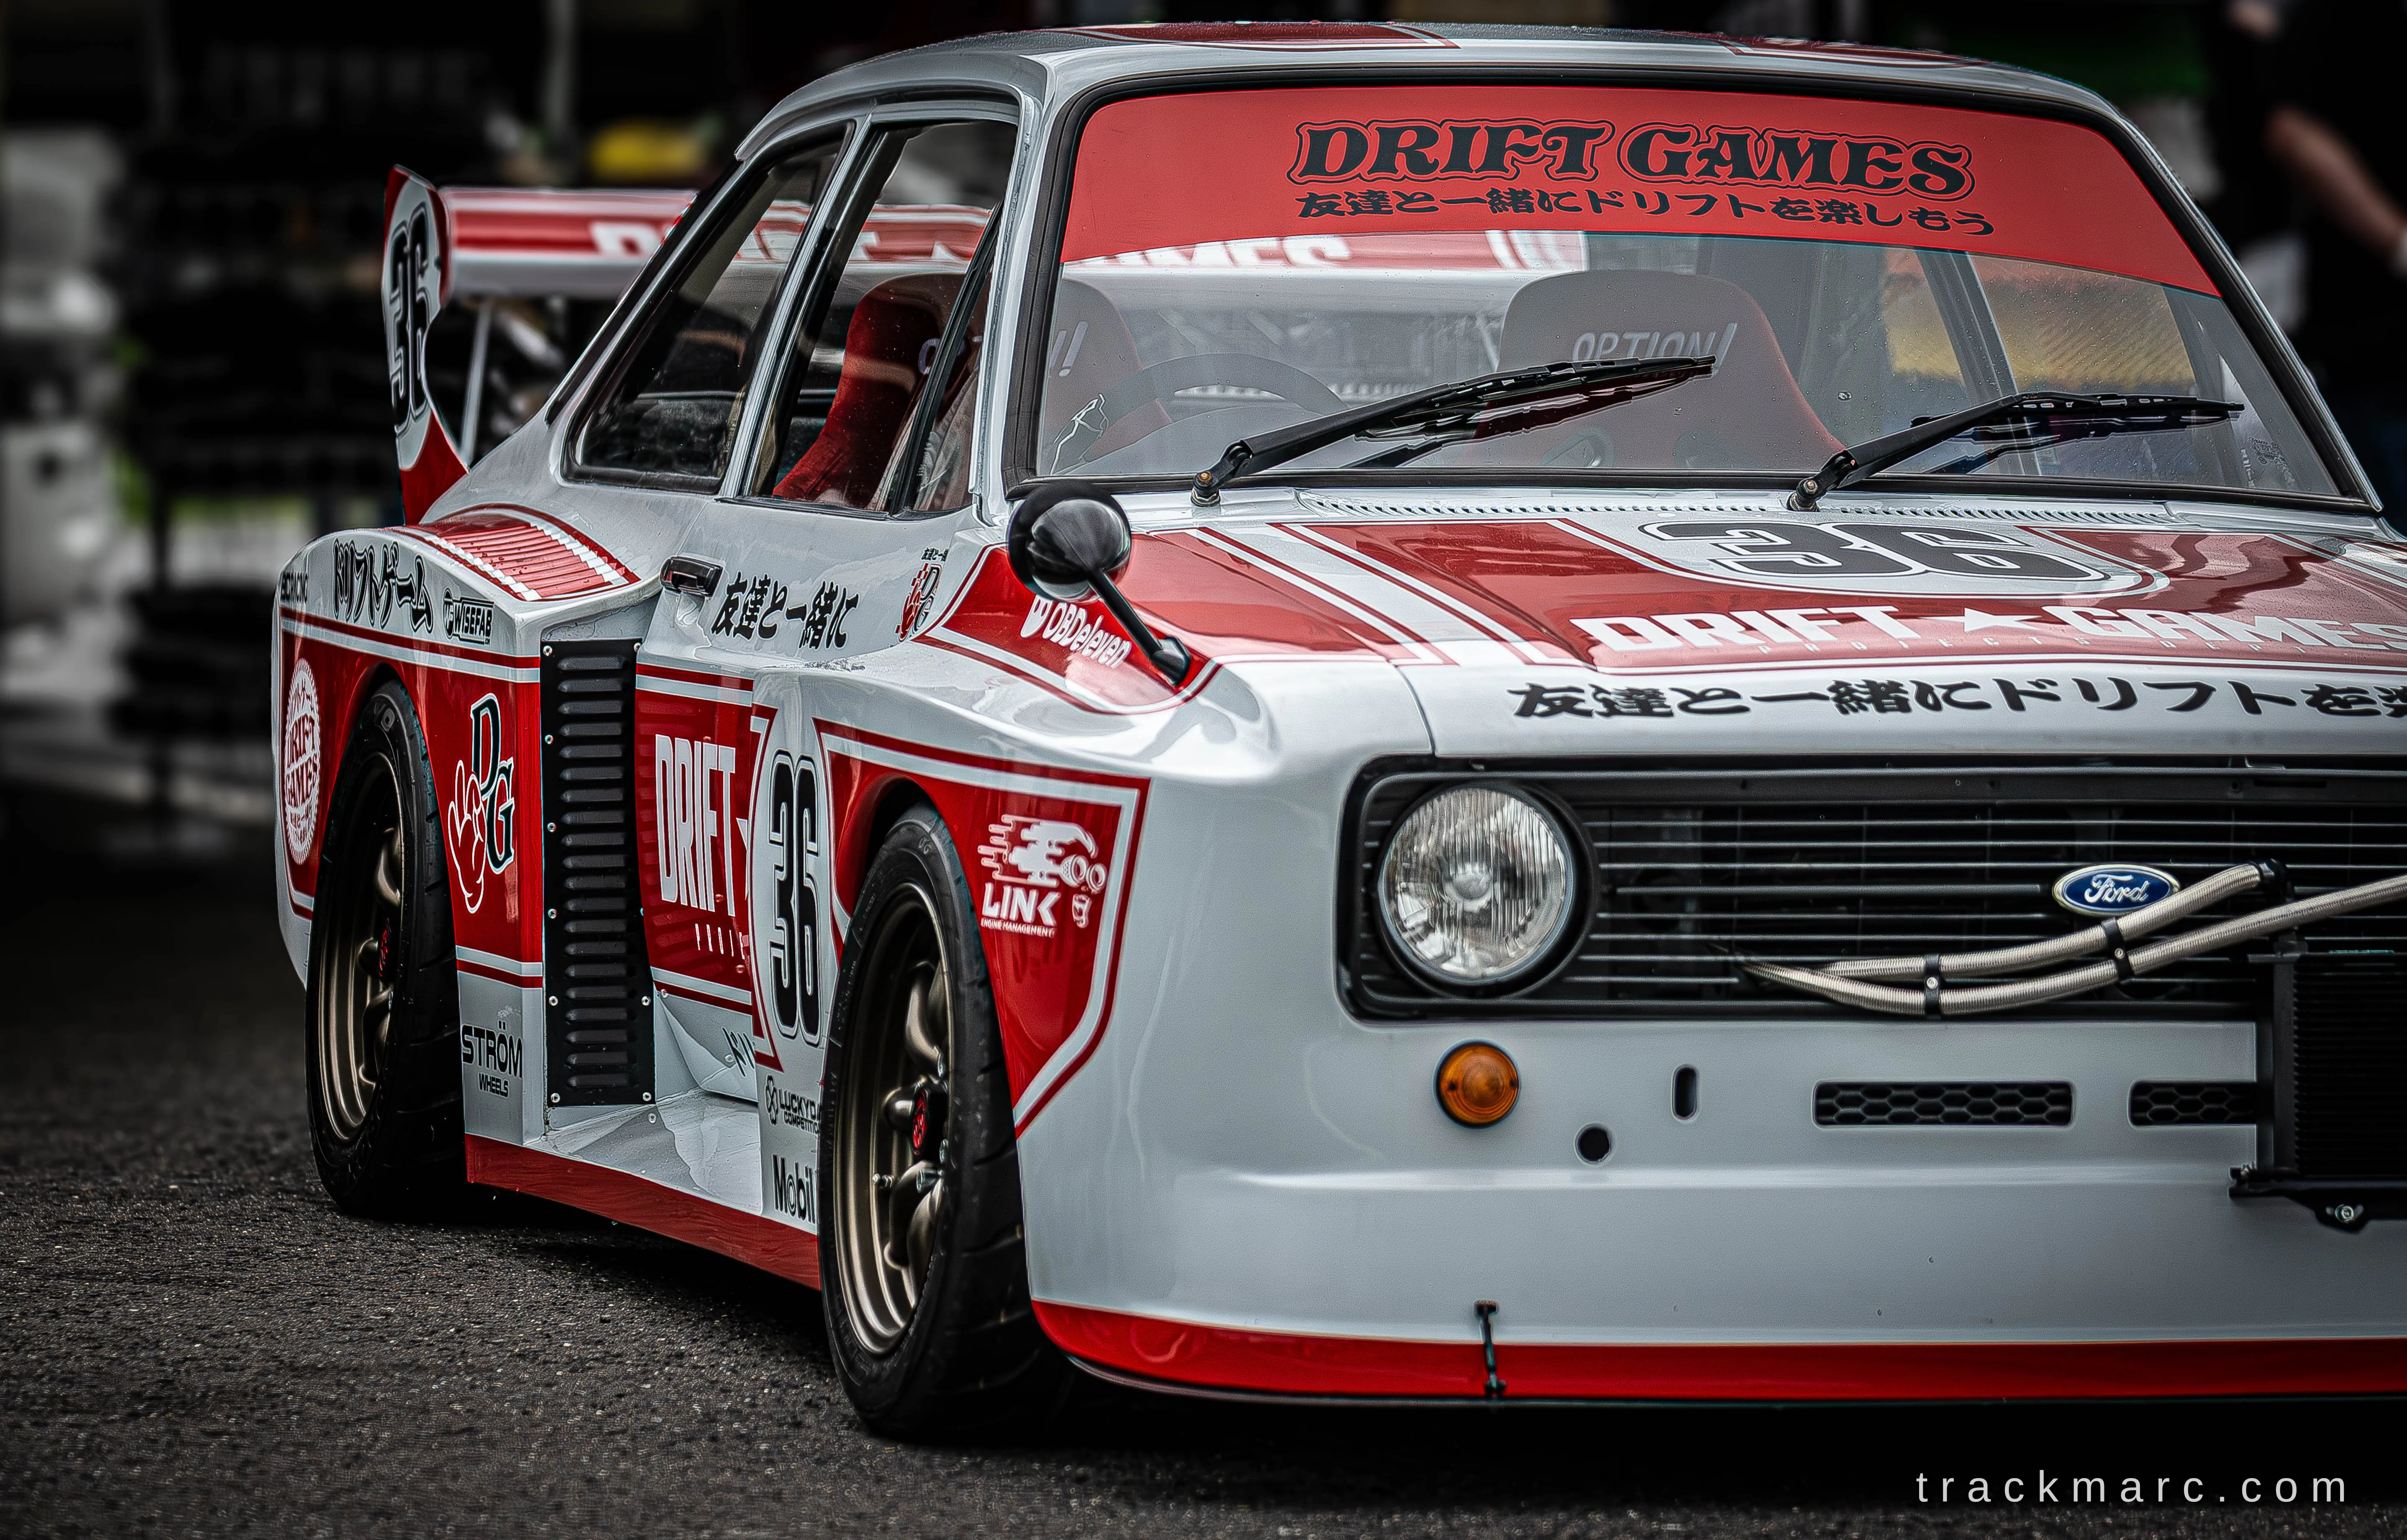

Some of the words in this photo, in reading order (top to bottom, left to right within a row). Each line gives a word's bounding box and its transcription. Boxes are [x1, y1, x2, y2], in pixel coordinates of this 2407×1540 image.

[1287, 119, 1614, 184] DRIFT
[1617, 122, 1974, 202] GAMES
[1294, 187, 1995, 236] 友達と一緒にドリフトを楽しもう
[1638, 520, 2111, 580] 36
[455, 604, 492, 637] WISEFAB
[710, 571, 859, 650] 友達と一緒に
[1042, 603, 1132, 669] OBDeleven
[1570, 606, 1921, 652] DRIFT
[287, 713, 315, 768] DRIFT
[285, 753, 318, 809] GAMES
[655, 734, 736, 917] DRIFT
[769, 749, 822, 1046] 36
[982, 882, 1062, 927] LINK
[2084, 874, 2150, 903] Ford
[981, 917, 1002, 930] ENGINE
[462, 1020, 523, 1078] STRÖM
[479, 1072, 509, 1098] WHEELS
